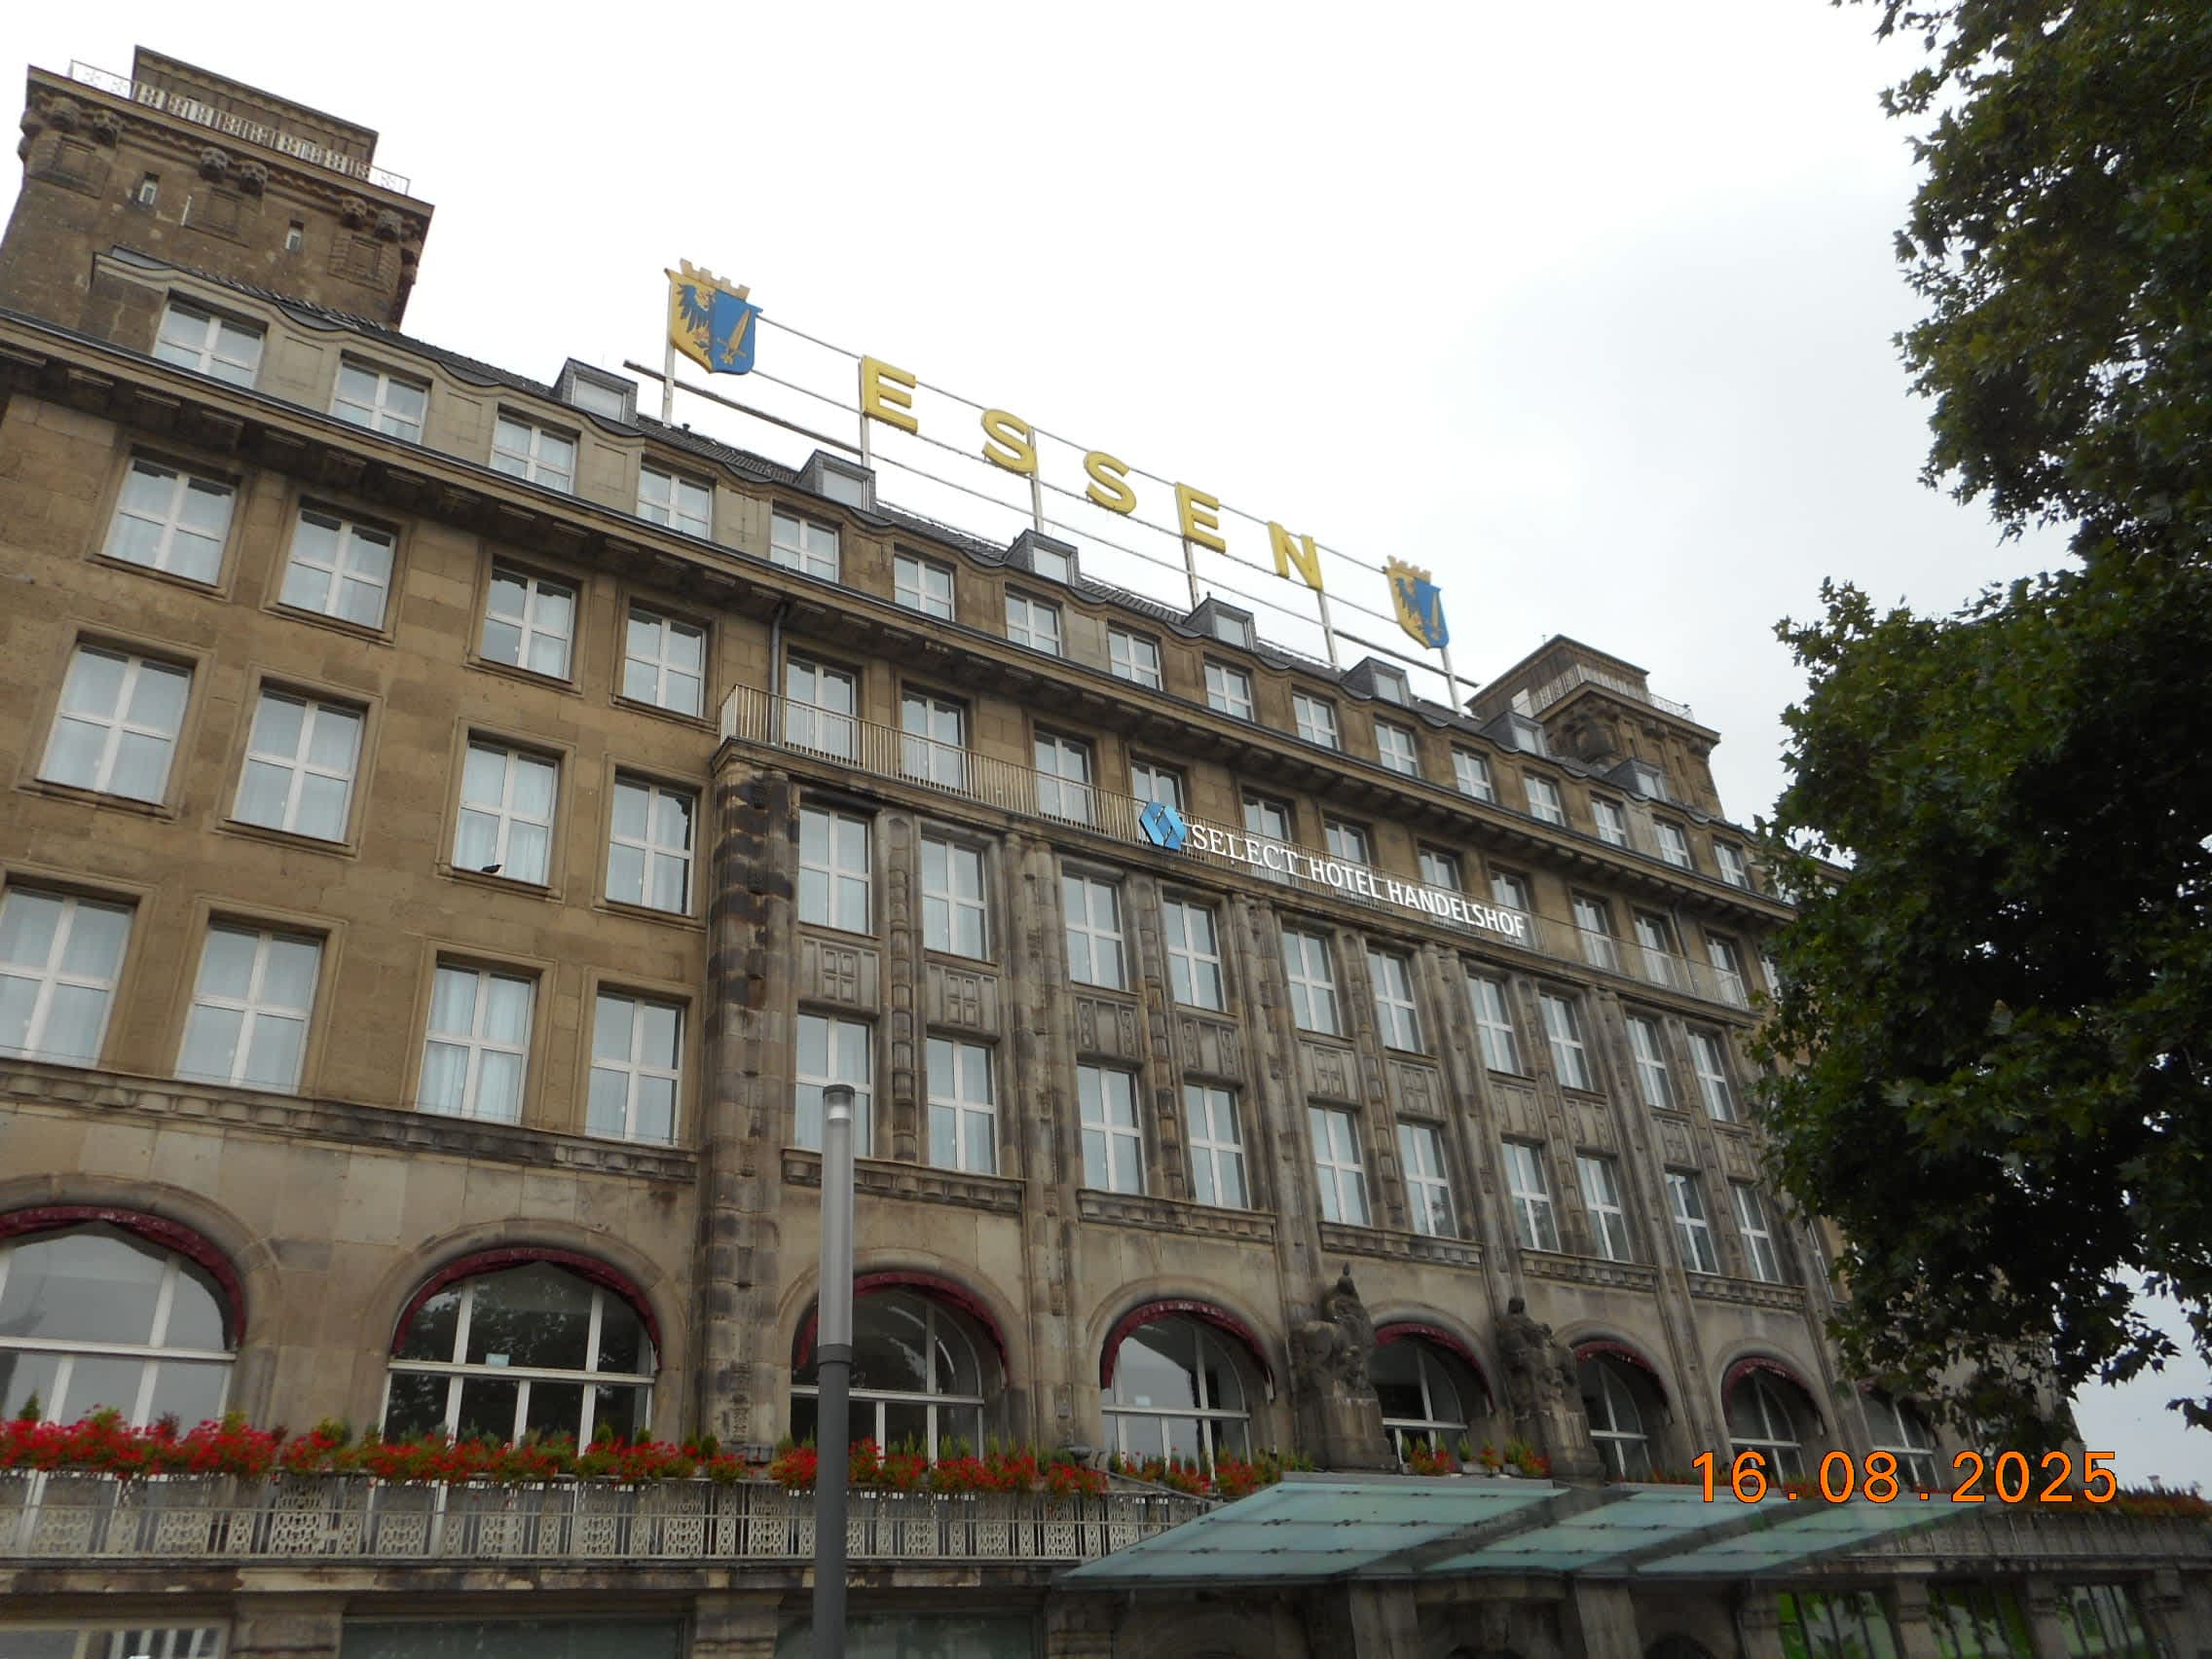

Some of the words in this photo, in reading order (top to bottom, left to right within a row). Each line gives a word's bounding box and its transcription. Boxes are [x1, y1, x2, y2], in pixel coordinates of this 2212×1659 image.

[861, 354, 1323, 591] ESSEN
[1192, 824, 1299, 876] SELECT
[1309, 856, 1382, 899] HOTEL
[1387, 879, 1525, 939] HANDELSHOF
